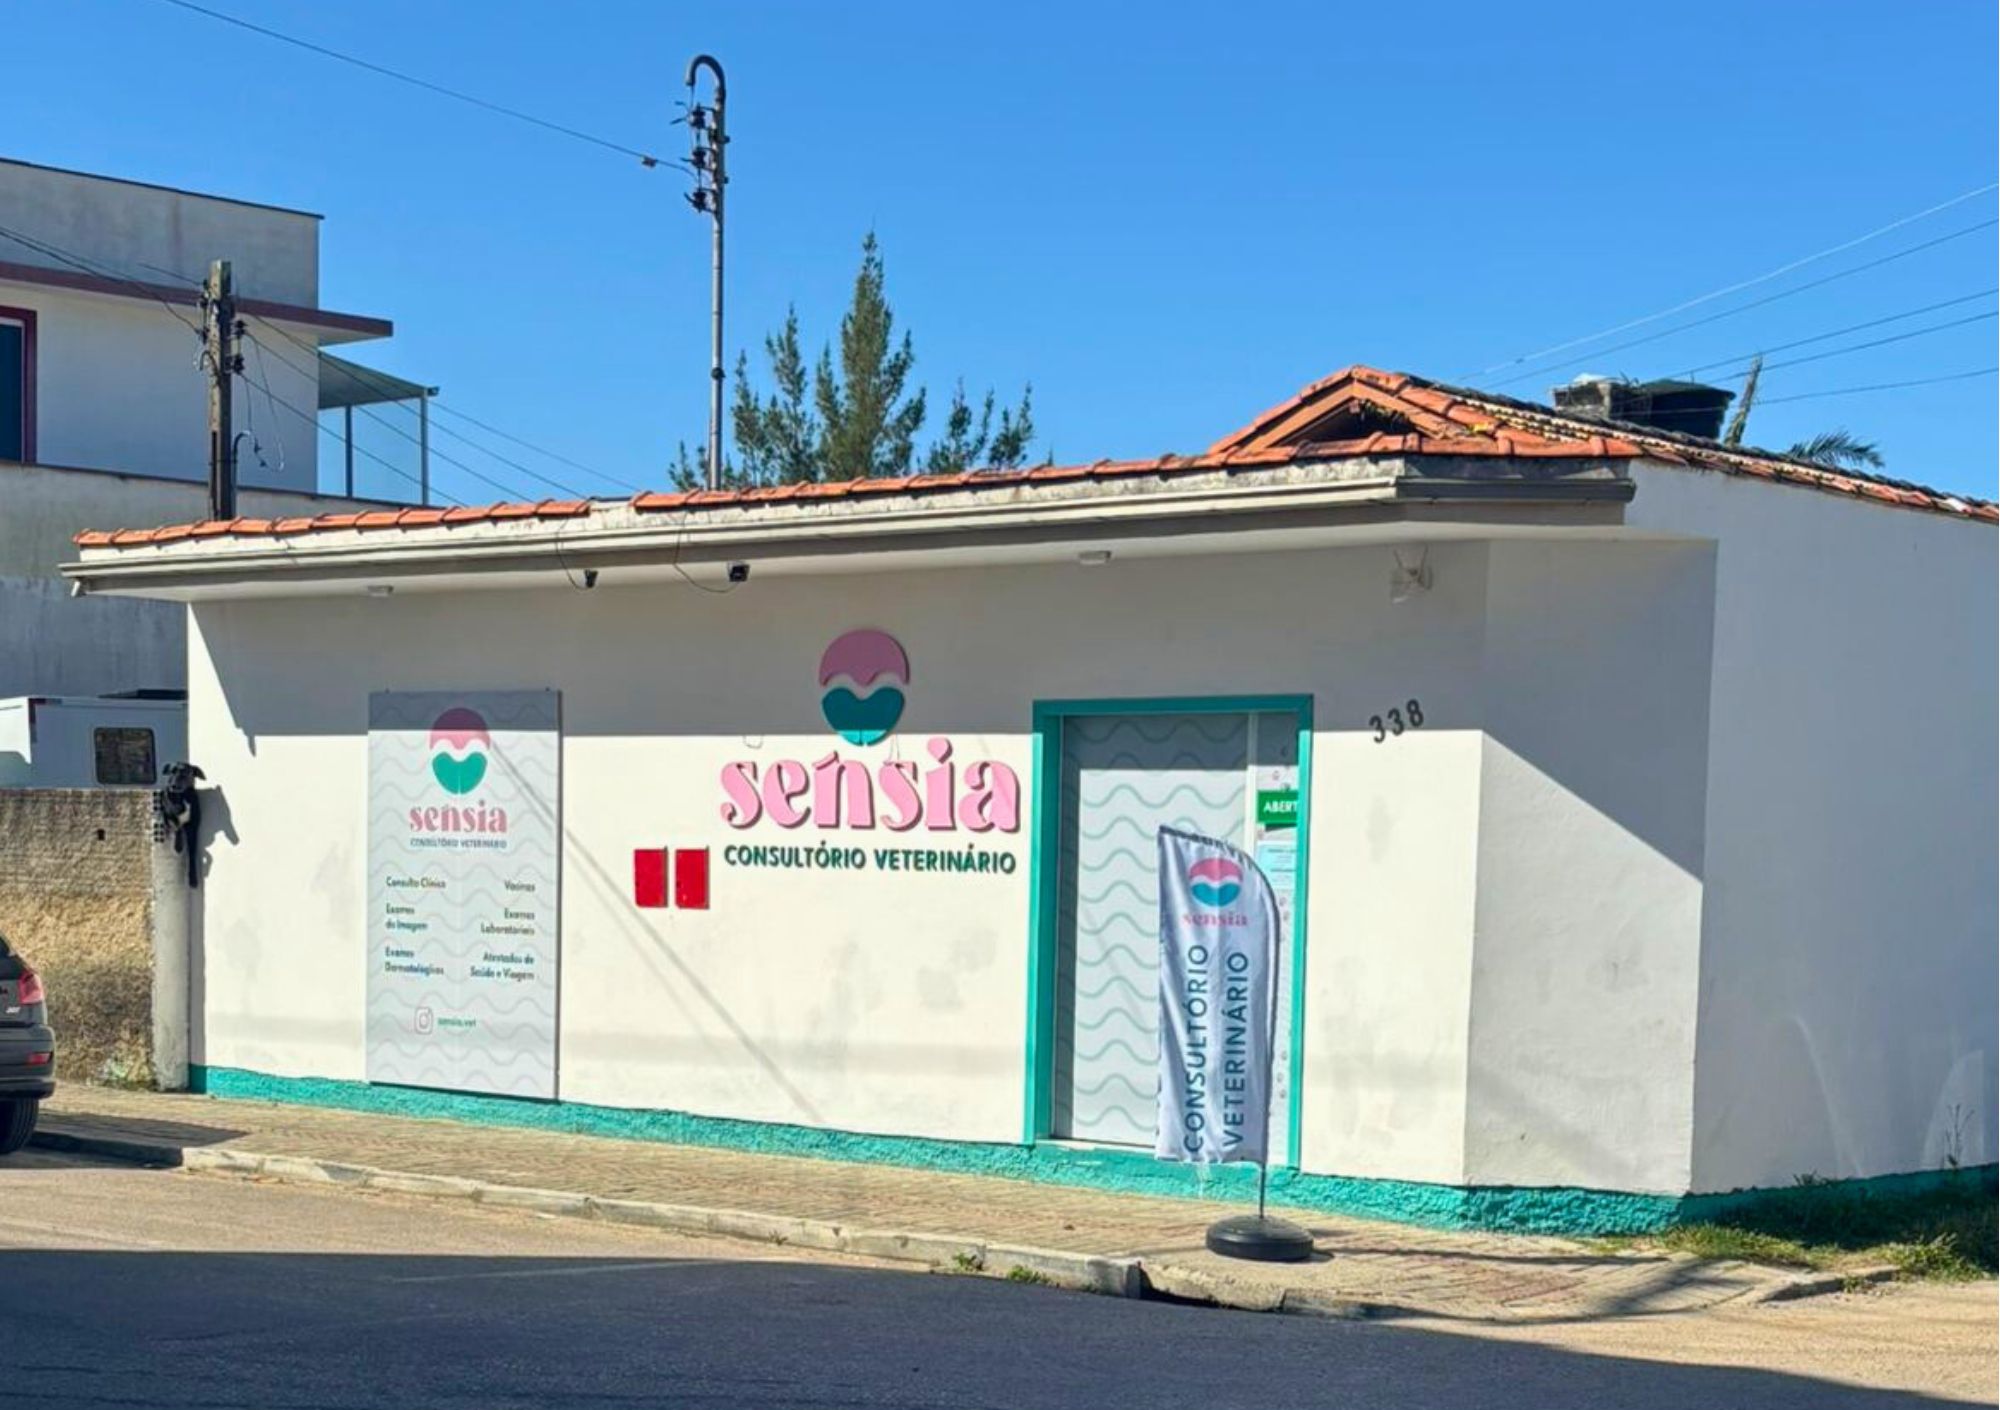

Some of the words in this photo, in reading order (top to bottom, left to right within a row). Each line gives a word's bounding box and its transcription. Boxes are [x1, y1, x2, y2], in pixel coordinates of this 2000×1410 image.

[1369, 699, 1424, 743] 338
[410, 799, 507, 833] sensia
[720, 737, 1020, 833] sensia
[724, 840, 866, 869] CONSULTÓRIO
[873, 843, 1017, 875] VETERINÁRIO
[1183, 944, 1209, 1153] CONSULTÓRIO
[1221, 951, 1250, 1149] VETERINÁRIO
